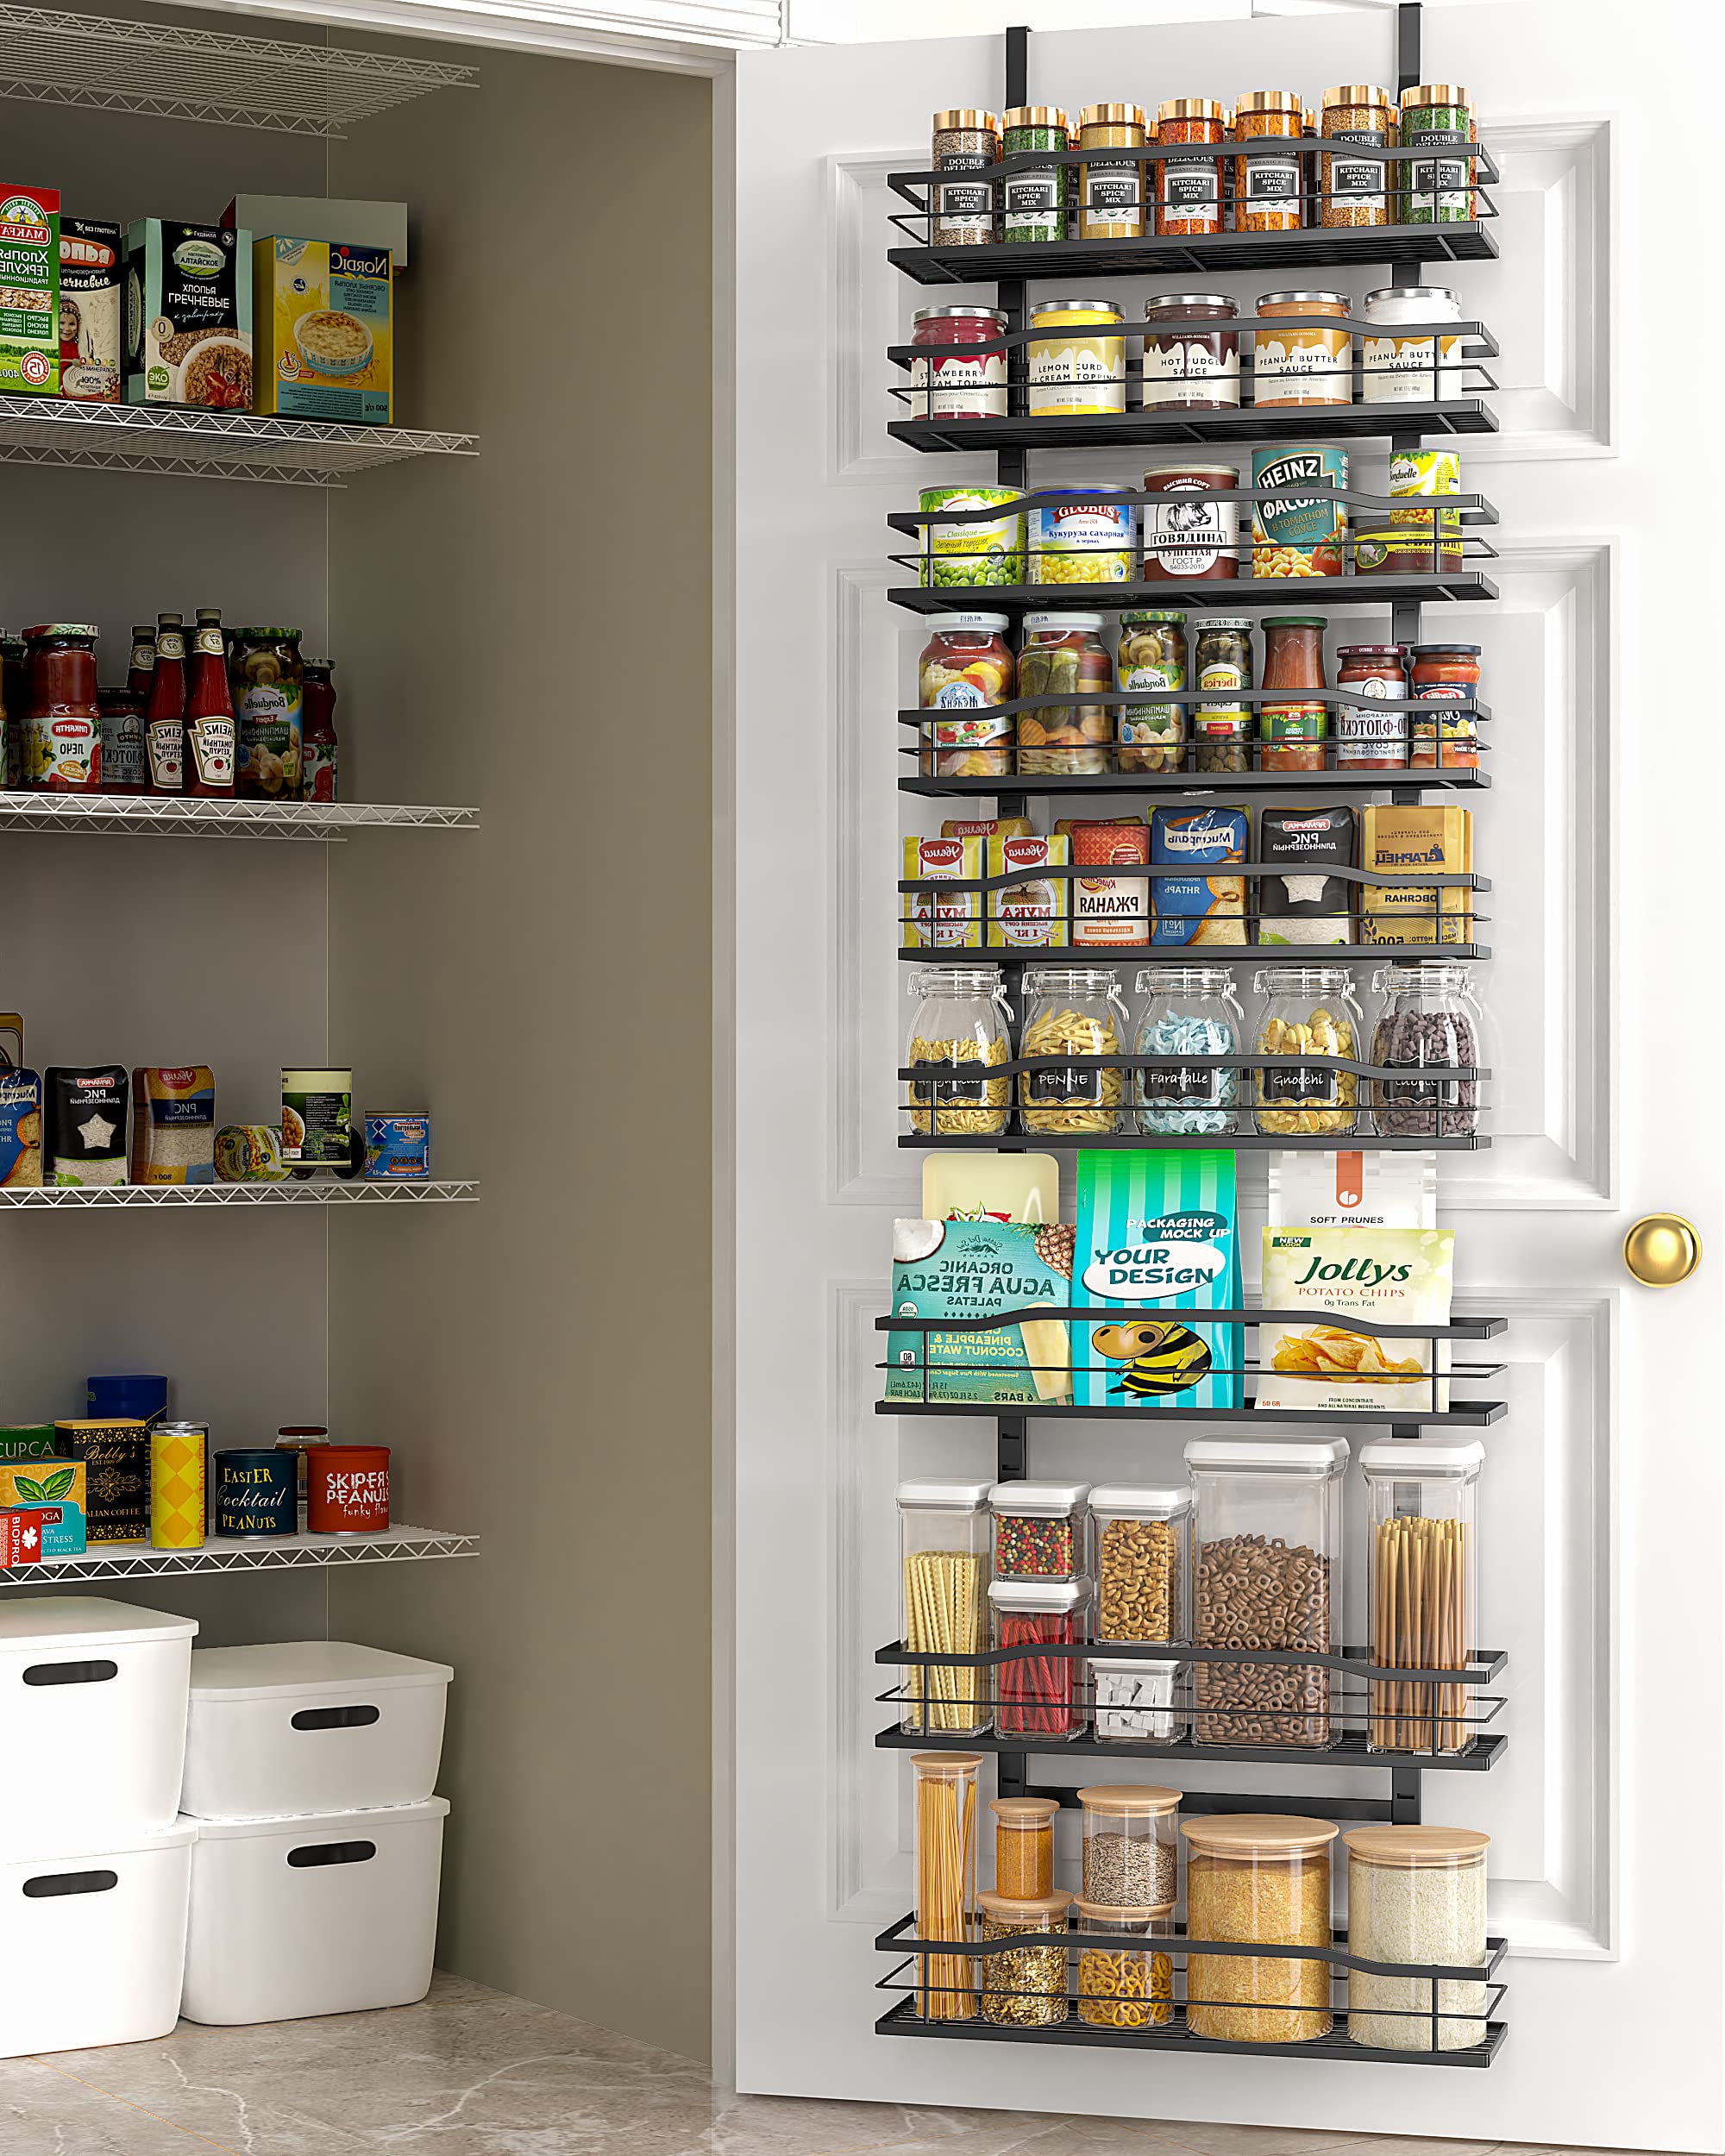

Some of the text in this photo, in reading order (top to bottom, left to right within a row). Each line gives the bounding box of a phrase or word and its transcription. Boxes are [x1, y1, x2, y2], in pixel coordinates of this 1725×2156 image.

[1340, 135, 1377, 143] DOUBLE
[1421, 135, 1458, 143] DOUBLE
[949, 158, 985, 166] DOUBLE
[1339, 166, 1378, 175] KITCHARI
[1255, 172, 1293, 180] KITCHARI
[1171, 178, 1210, 186] KITCHARI
[948, 187, 985, 197] KITCHARI
[1012, 186, 1049, 195] KITCHARI
[1094, 184, 1132, 192] KITCHARI
[180, 257, 219, 267] АЛТАЙСКОЕ
[182, 283, 216, 296] ХЛОПЬЯ
[168, 293, 230, 309] ГРЕЧНЕВЫЕ
[1161, 358, 1182, 367] HOT
[1260, 354, 1338, 367] PEANUT BUTTER
[1369, 353, 1404, 363] PEANUT
[1038, 363, 1102, 373] LEMON CURD
[1279, 365, 1313, 374] SAUCE
[1389, 360, 1423, 370] SAUCE
[1173, 367, 1207, 376] SAUCE
[149, 372, 168, 382] ЭКО
[1039, 374, 1070, 384] CREAM
[1262, 459, 1318, 489] HEINZ
[1163, 477, 1211, 492] ВЫСШИЙ СОРТ
[1058, 505, 1115, 517] GLOBUS
[1272, 508, 1329, 532] В ТОМАТНОМ
[947, 530, 978, 540] Classique
[1049, 530, 1124, 540] Кукуруза сахарная
[1289, 523, 1318, 538] СОУСЕ
[1153, 533, 1224, 546] ГОВЯДИНА
[1162, 548, 1212, 558] ТУШЕНАЯ
[1039, 1074, 1088, 1086] PENNE
[1150, 1072, 1208, 1087] Farafalle
[1273, 1074, 1323, 1086] Gnocchi
[1310, 1216, 1384, 1225] SOFT PRUNES
[1160, 1228, 1232, 1239] MOCK UP
[1095, 1249, 1170, 1266] YOUR
[1295, 1256, 1413, 1288] Jollys
[1299, 1288, 1406, 1298] POTATO CHIPS
[85, 1445, 138, 1465] Bobby's
[224, 1468, 273, 1484] EASTER
[217, 1485, 287, 1508] Cocktail
[111, 1507, 141, 1518] COFFEE
[343, 1504, 372, 1520] funky
[223, 1514, 277, 1531] PEANUTS
[43, 1534, 74, 1545] STRESS
